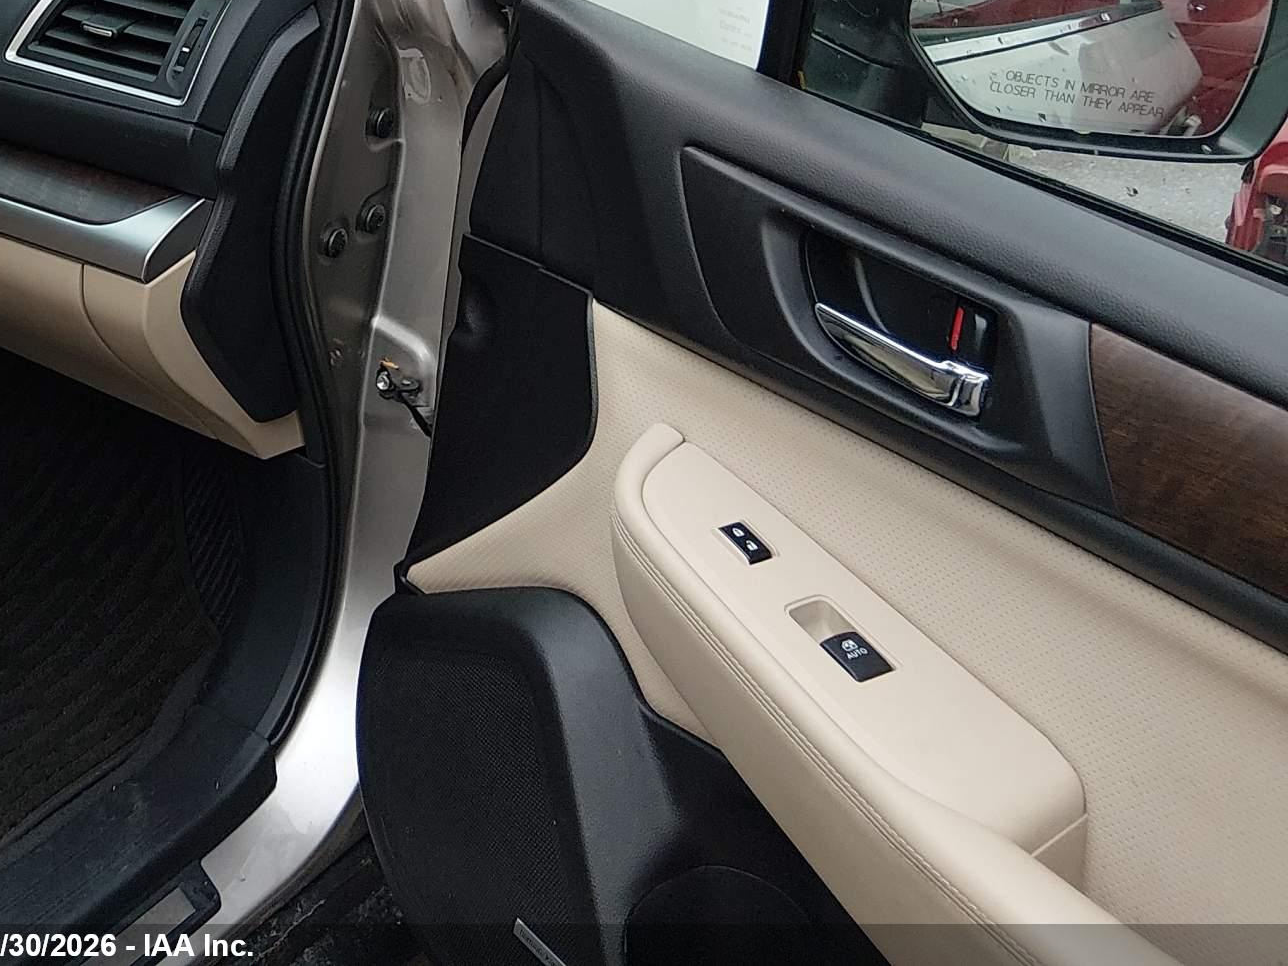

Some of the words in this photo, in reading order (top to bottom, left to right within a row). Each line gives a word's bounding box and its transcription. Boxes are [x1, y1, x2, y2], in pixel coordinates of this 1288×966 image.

[989, 80, 1036, 98] CLOSER
[1044, 89, 1076, 104] THAN
[1083, 96, 1113, 110] THEY
[1118, 101, 1165, 118] APPEAR
[1005, 70, 1060, 89] OBJECTS
[1064, 79, 1076, 91] IN
[1080, 82, 1126, 98] MIRROR
[1130, 90, 1156, 103] ARE
[846, 647, 868, 660] AUTO
